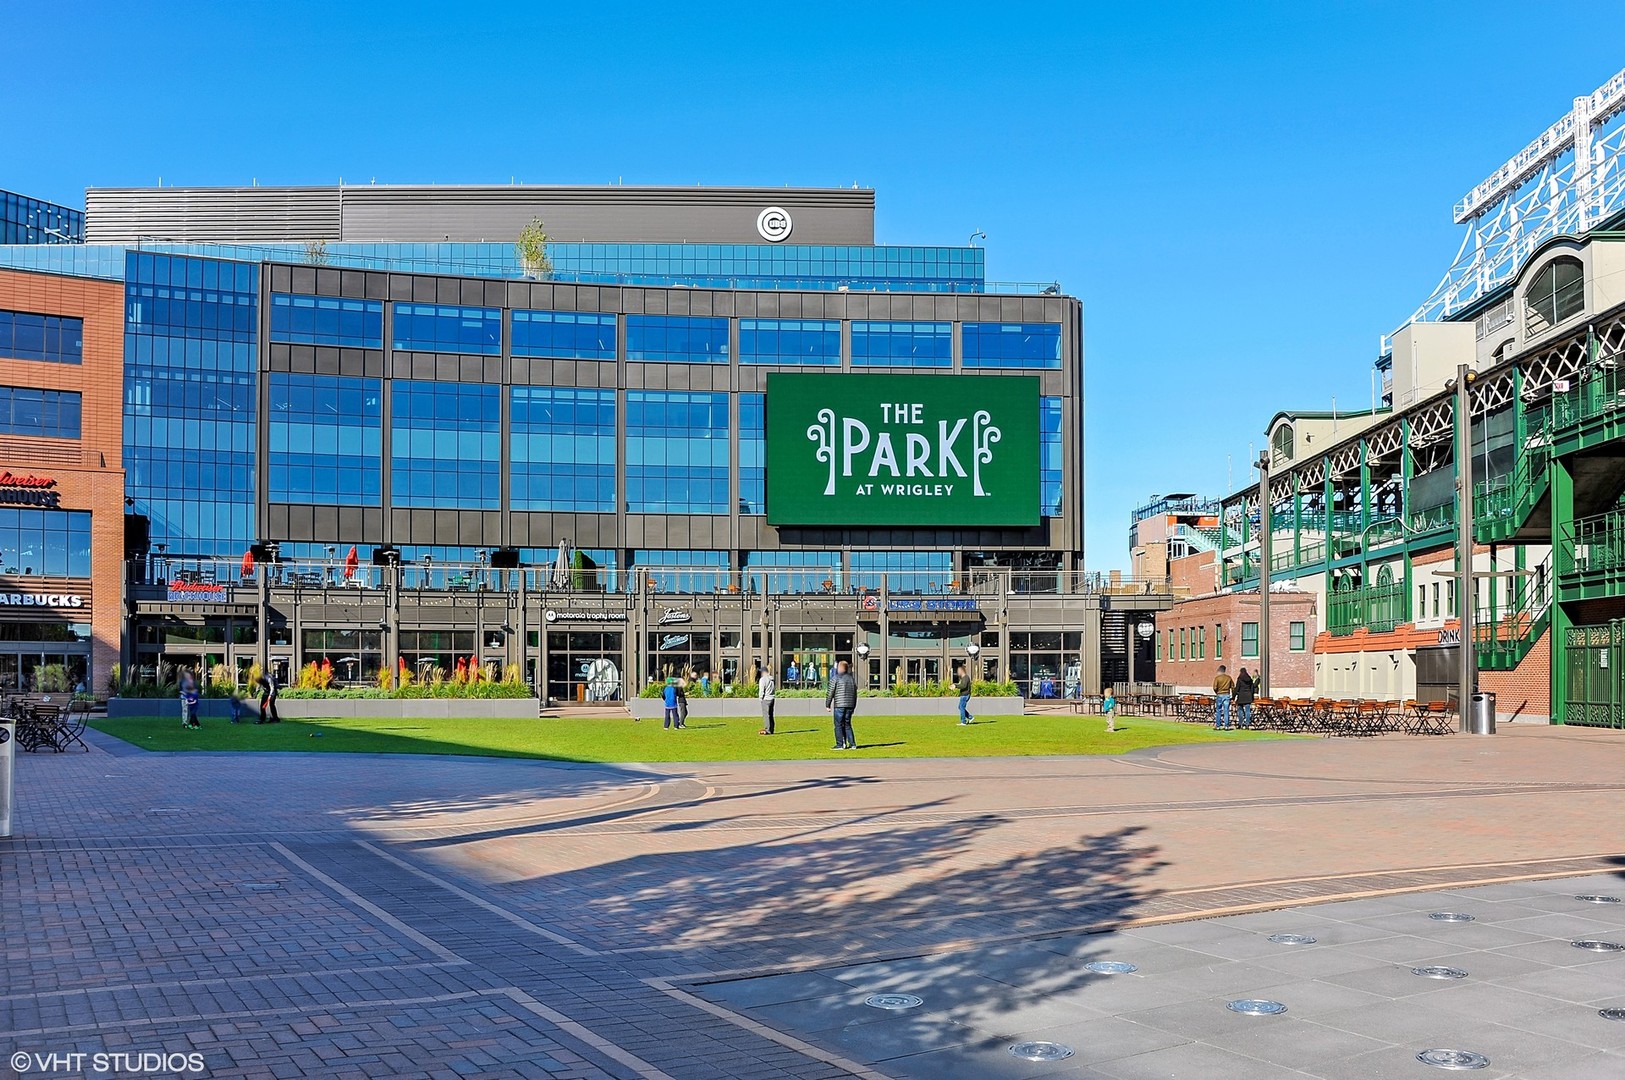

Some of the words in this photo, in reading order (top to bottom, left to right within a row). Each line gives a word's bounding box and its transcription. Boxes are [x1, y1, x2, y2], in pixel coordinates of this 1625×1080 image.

[880, 403, 924, 424] THE
[842, 417, 968, 477] PARK
[855, 484, 874, 496] AT
[880, 484, 954, 496] WRIGLEY
[169, 580, 225, 592] Budweiser
[586, 611, 608, 620] trophy
